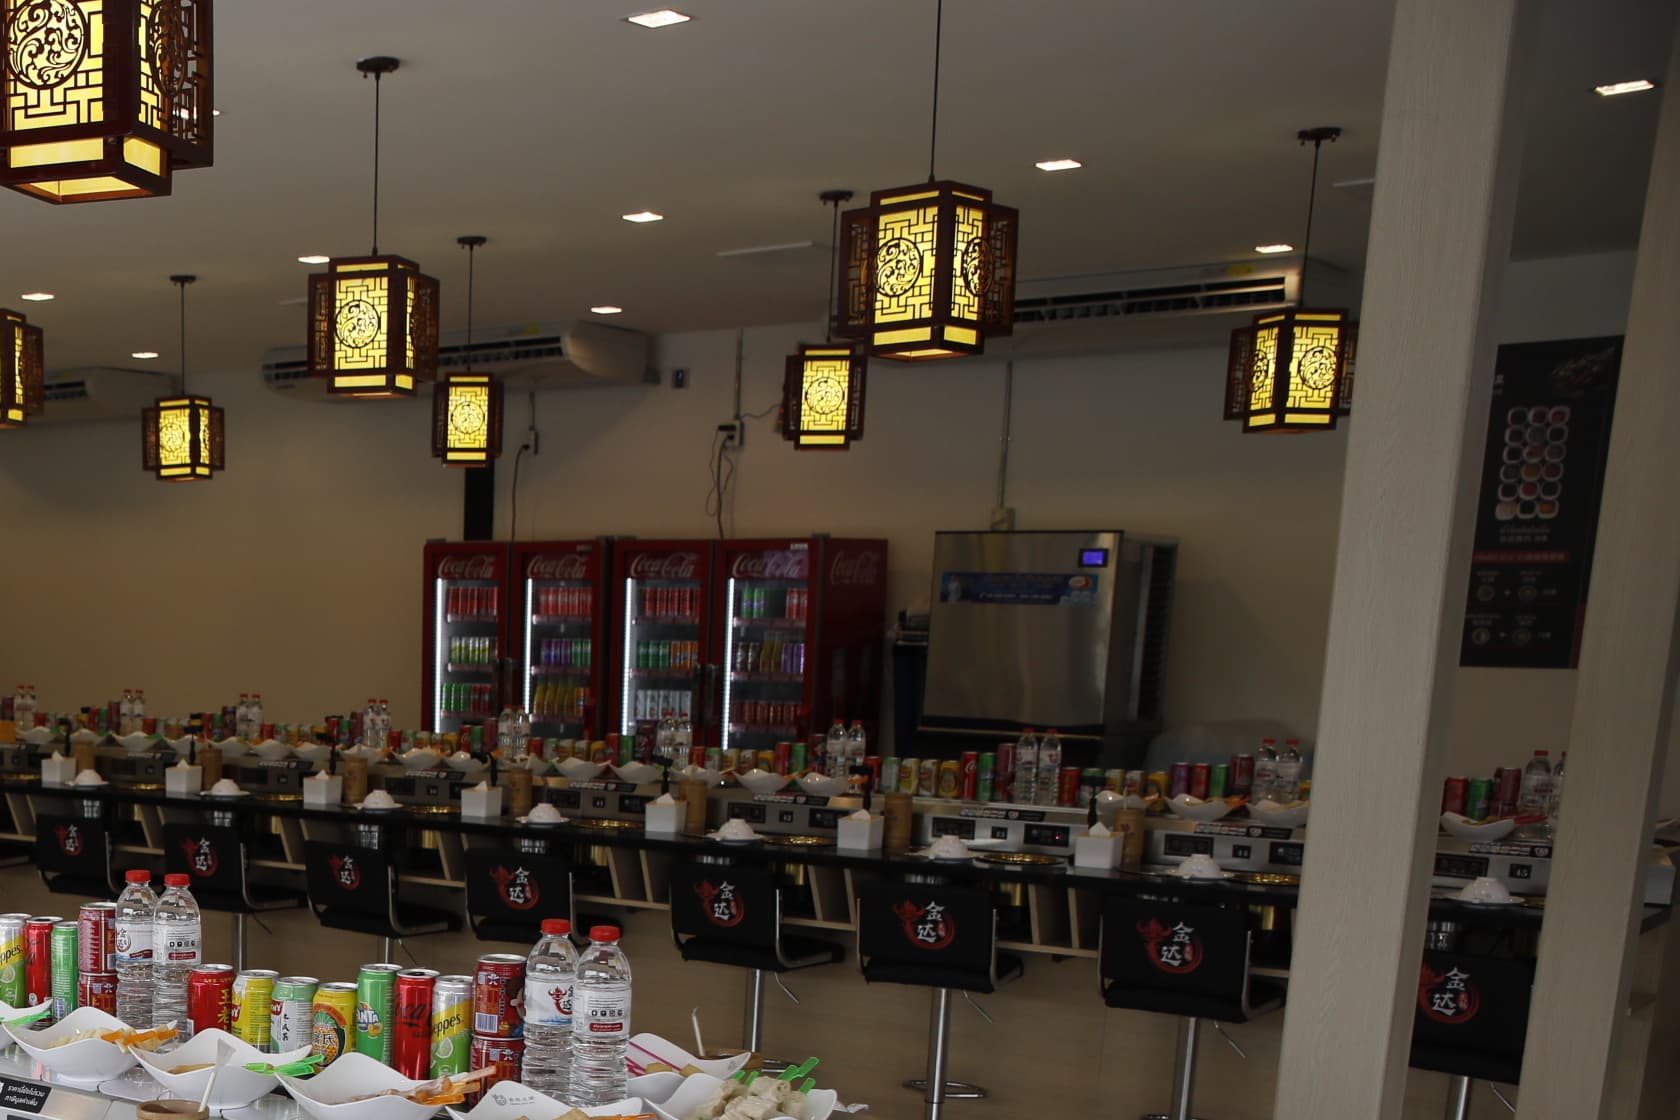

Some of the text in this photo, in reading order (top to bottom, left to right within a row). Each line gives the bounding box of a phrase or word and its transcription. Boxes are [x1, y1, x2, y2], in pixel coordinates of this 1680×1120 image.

[509, 866, 531, 905] 金达
[713, 880, 736, 921] 金达
[917, 901, 945, 943] 金达
[1160, 921, 1195, 967] 金达
[1432, 967, 1470, 1017] 金达
